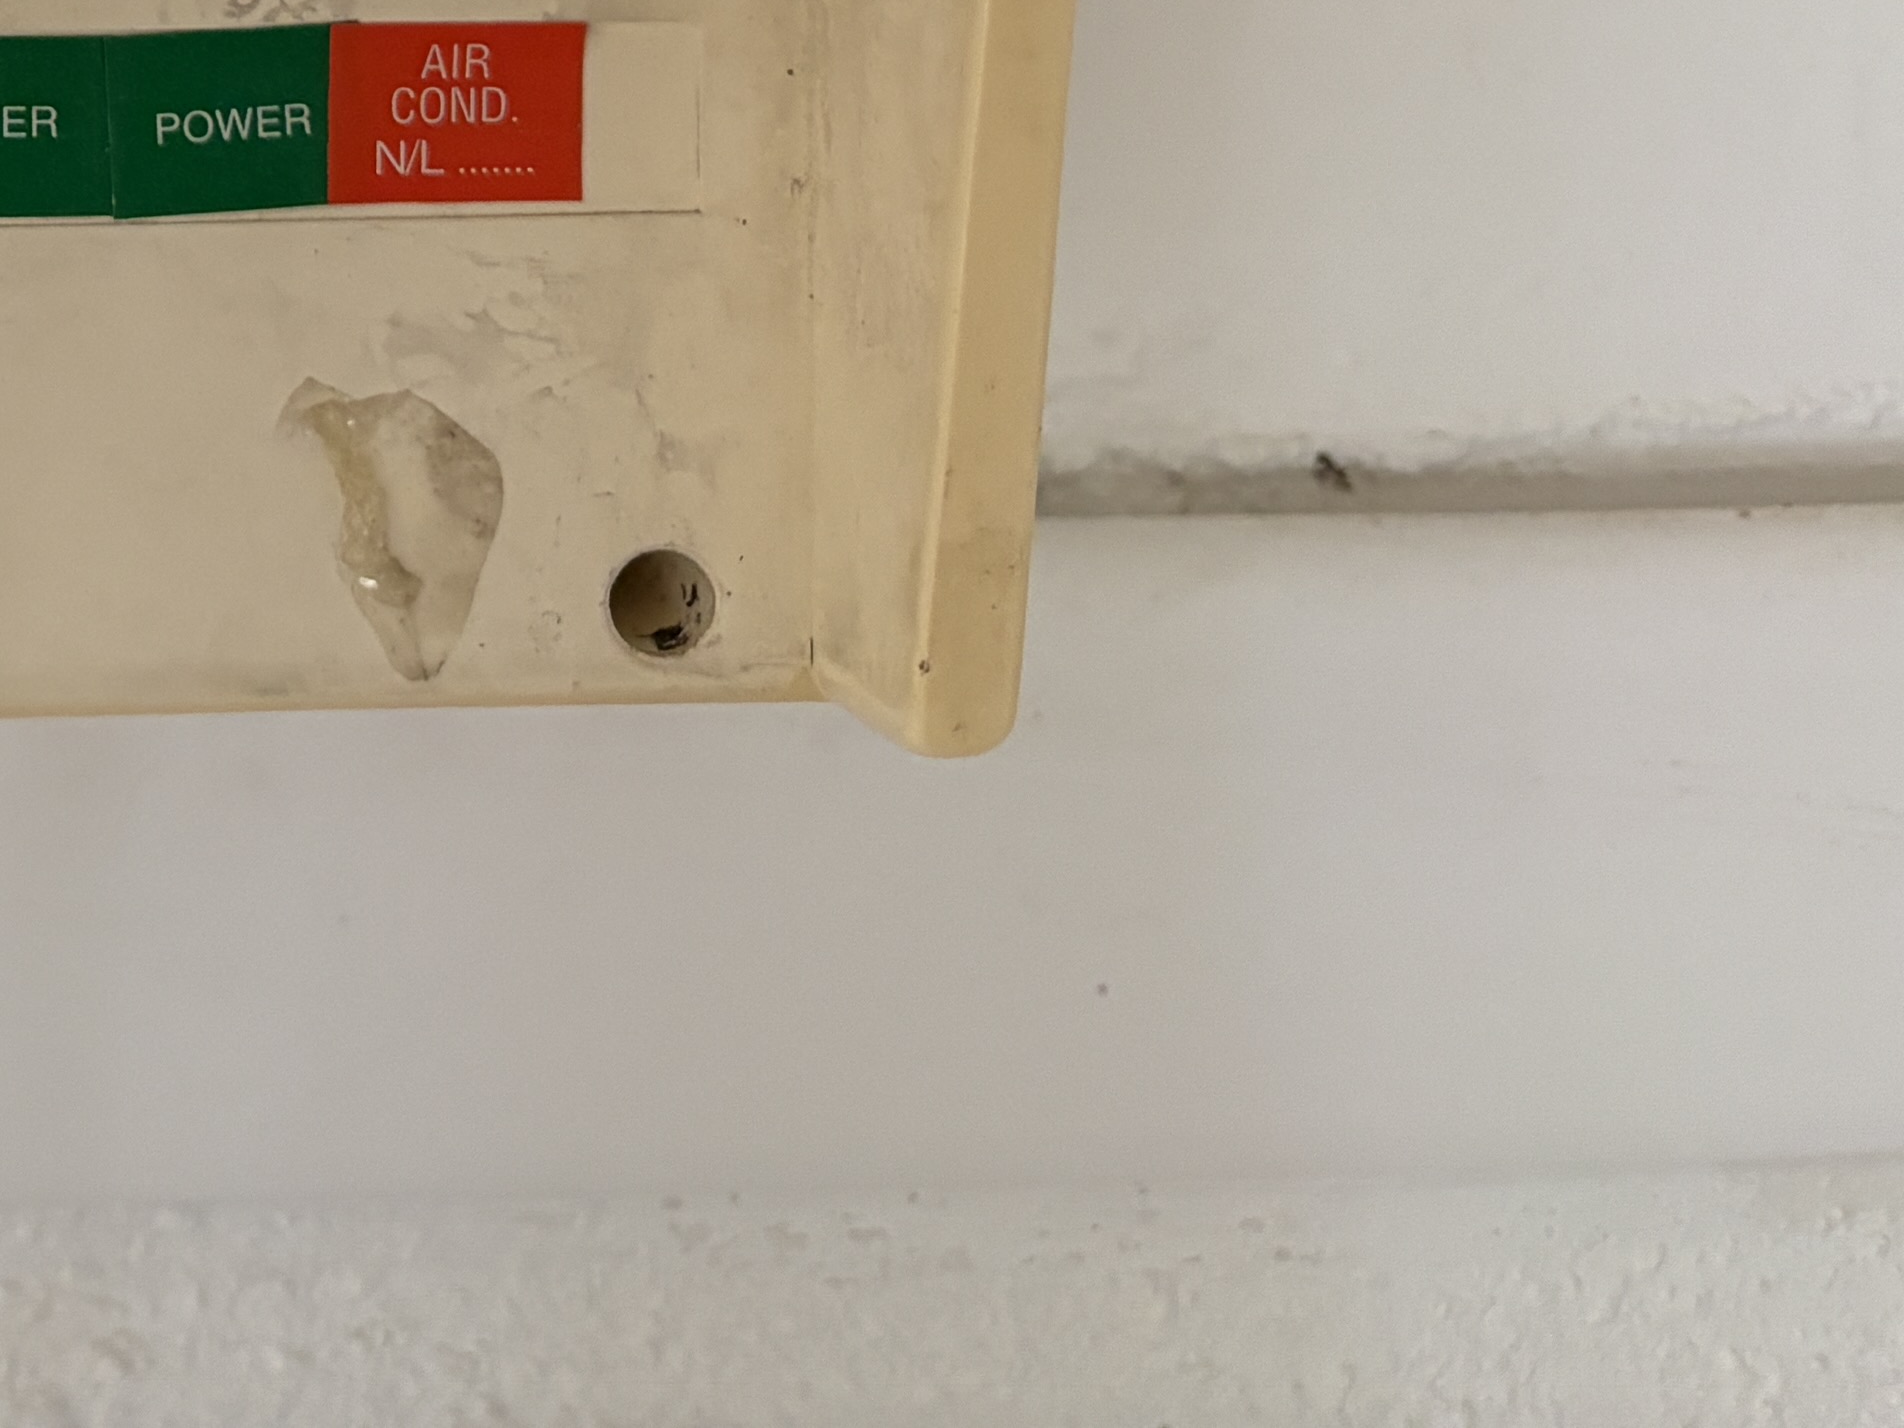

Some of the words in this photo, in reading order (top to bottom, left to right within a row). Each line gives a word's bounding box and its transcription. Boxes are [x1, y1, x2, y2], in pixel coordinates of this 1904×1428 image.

[421, 43, 490, 80] AIR
[155, 103, 313, 144] POWER
[391, 86, 518, 125] COND.
[376, 139, 444, 176] N/L
